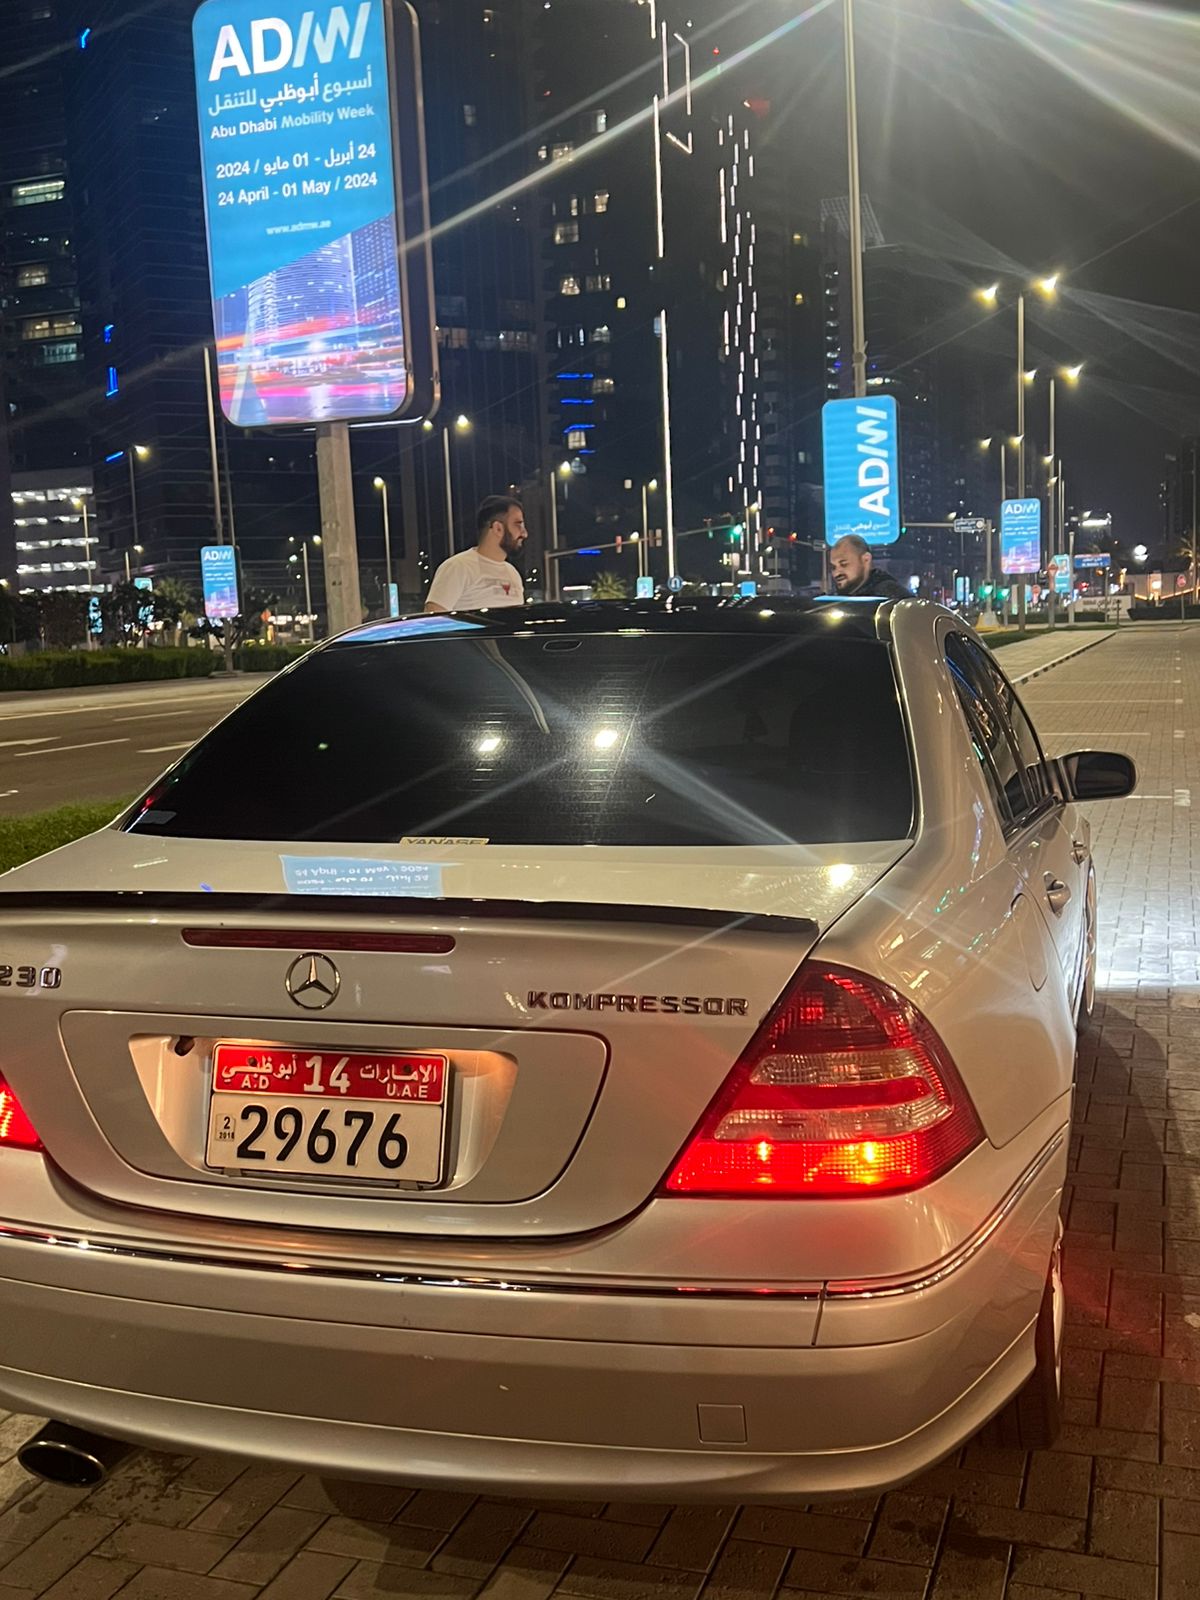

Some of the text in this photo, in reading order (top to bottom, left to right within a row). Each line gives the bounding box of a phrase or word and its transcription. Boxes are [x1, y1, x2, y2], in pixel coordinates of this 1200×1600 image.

[208, 65, 372, 117] أسبوع أبوظبي للتنقل
[211, 104, 375, 139] Abu Dhabi Mobility Week
[292, 153, 309, 168] 01
[324, 141, 355, 168] أبريل
[358, 143, 376, 159] 24
[216, 163, 250, 179] 2024
[263, 156, 289, 176] مايو
[218, 191, 235, 206] 24
[238, 186, 269, 205] April
[282, 182, 297, 197] 01
[302, 179, 331, 195] May
[344, 172, 378, 188] 2024
[0, 965, 61, 989] 230
[527, 990, 749, 1016] KOMPRESSOR
[221, 1054, 298, 1082] أبوظبي
[304, 1055, 350, 1094] 14
[386, 1083, 428, 1098] U.A.E
[223, 1116, 231, 1129] 2
[237, 1104, 408, 1169] 29676
